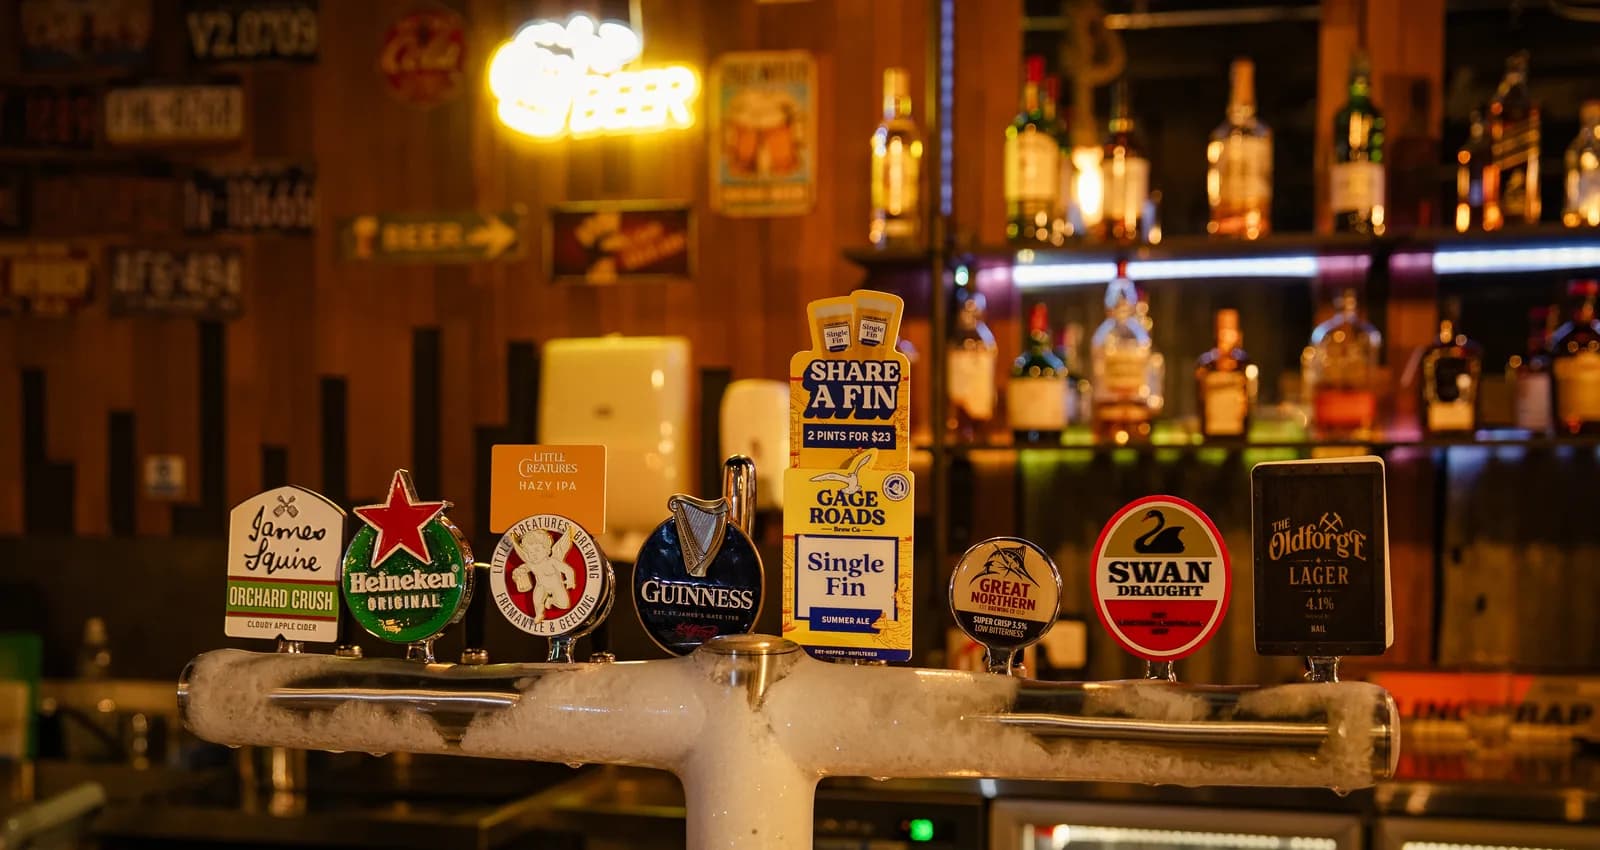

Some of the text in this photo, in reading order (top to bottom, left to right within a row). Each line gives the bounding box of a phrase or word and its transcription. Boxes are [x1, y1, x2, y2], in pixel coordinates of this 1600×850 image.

[570, 66, 702, 137] BEER
[382, 222, 462, 252] BEER
[826, 330, 848, 338] Single
[862, 323, 884, 333] Single
[810, 361, 899, 382] SHARE
[811, 384, 896, 409] A FIN
[808, 431, 891, 443] 2 PINTS FOR $23
[534, 452, 566, 462] LITTLE
[519, 458, 578, 478] CREATURES
[519, 481, 577, 491] HAZY IPA
[816, 489, 879, 508] GAGE
[248, 505, 326, 542] James
[809, 507, 886, 526] ROADS
[1272, 517, 1291, 532] THE
[244, 539, 322, 575] Squire
[493, 517, 600, 579] LITTLE CREATURES BREWING
[807, 552, 885, 578] Single
[1108, 561, 1213, 584] SWAN
[350, 569, 458, 594] Heineken
[1289, 566, 1350, 585] LAGER
[641, 580, 754, 610] GUINNESS
[825, 576, 866, 597] Fin
[980, 578, 1031, 598] GREAT
[1117, 586, 1204, 598] DRAUGHT
[229, 586, 333, 611] ORCHARD CRUSH
[367, 594, 441, 612] ORIGINAL
[970, 592, 1036, 611] NORTHERN
[1305, 597, 1335, 611] 4.1%
[496, 592, 596, 633] FREMANTLE & GEELONG
[821, 615, 871, 625] SUMMER ALE
[247, 620, 317, 632] CLOUDY APPLE CIDER
[973, 615, 1028, 631] SUPER CRISP 3.5%
[975, 624, 1025, 639] LOW BITTERNESS
[1311, 624, 1327, 633] NAIL
